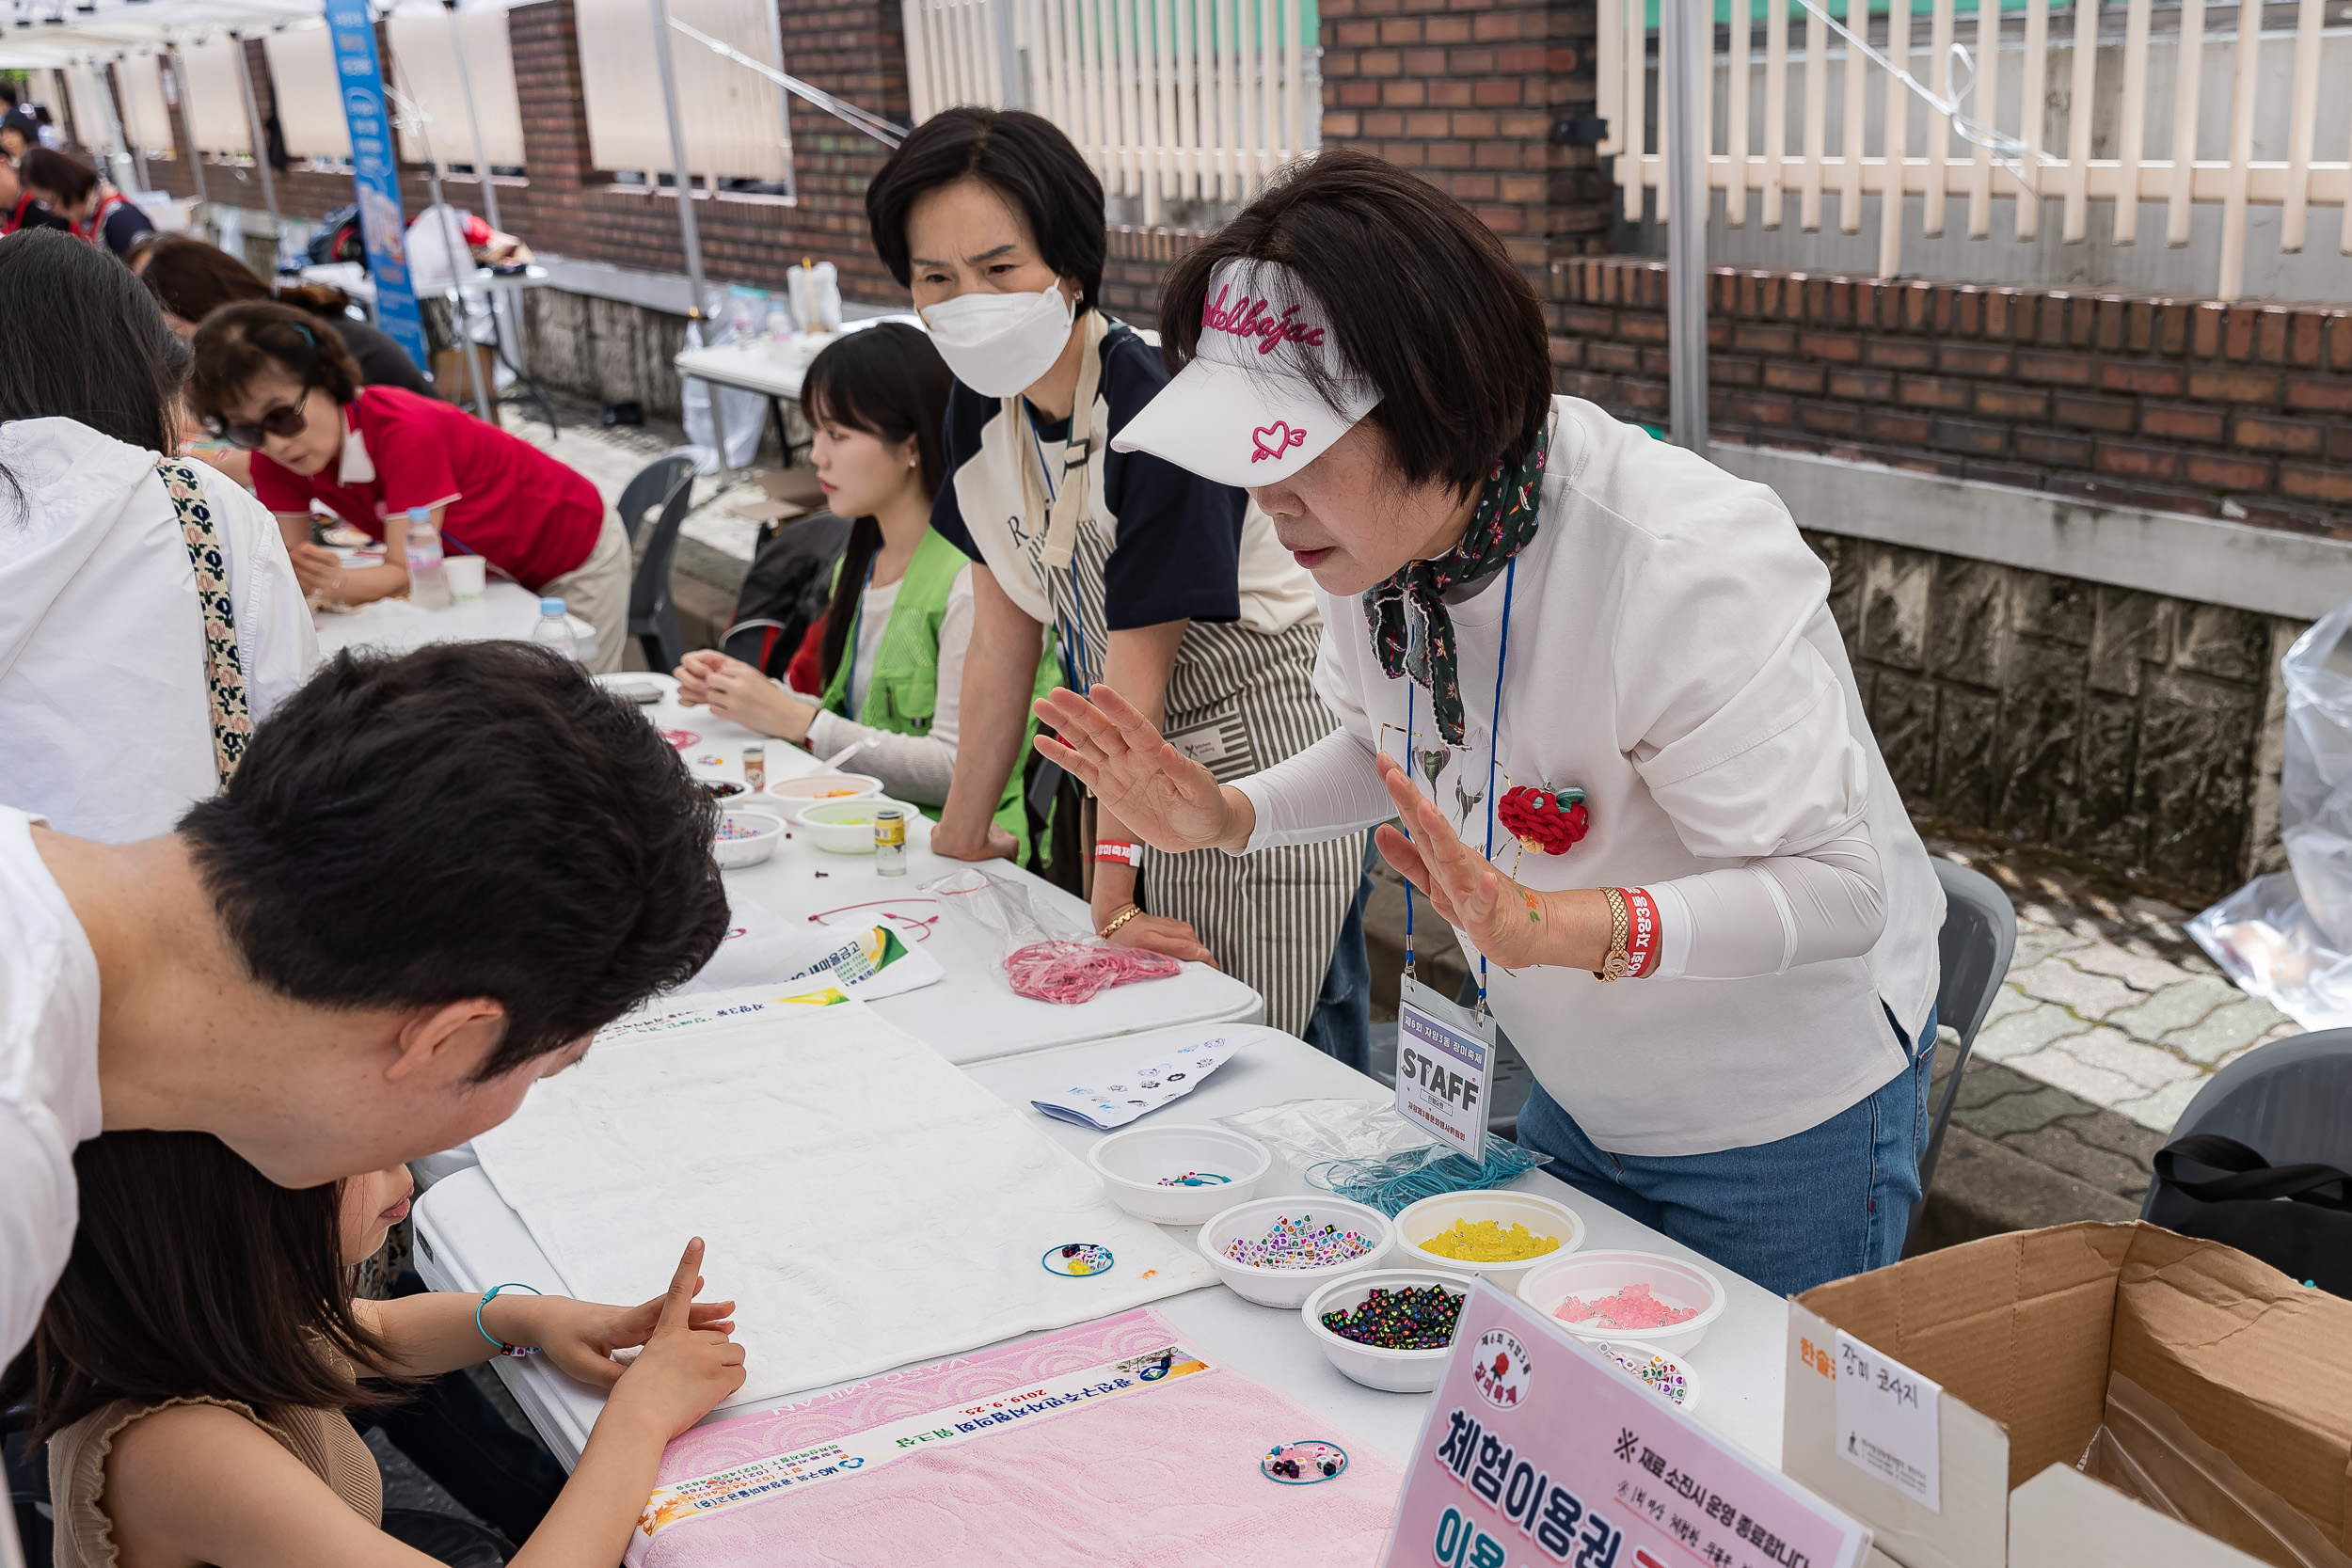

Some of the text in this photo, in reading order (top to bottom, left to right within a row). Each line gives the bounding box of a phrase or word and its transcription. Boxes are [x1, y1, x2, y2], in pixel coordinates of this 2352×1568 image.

[1631, 896, 1652, 947] 자양3동
[1405, 1016, 1483, 1065] 제6회 자양3동 장미축제
[1402, 1048, 1479, 1111] STAFF
[1842, 1343, 1869, 1381] 장미
[896, 1378, 1134, 1448] 광진구주민자치협의회 워크샵
[1438, 1410, 1621, 1568] 체험이용권
[1638, 1447, 1667, 1480] 재료
[1664, 1468, 1707, 1508] 소진시
[1706, 1495, 1737, 1528] 운영
